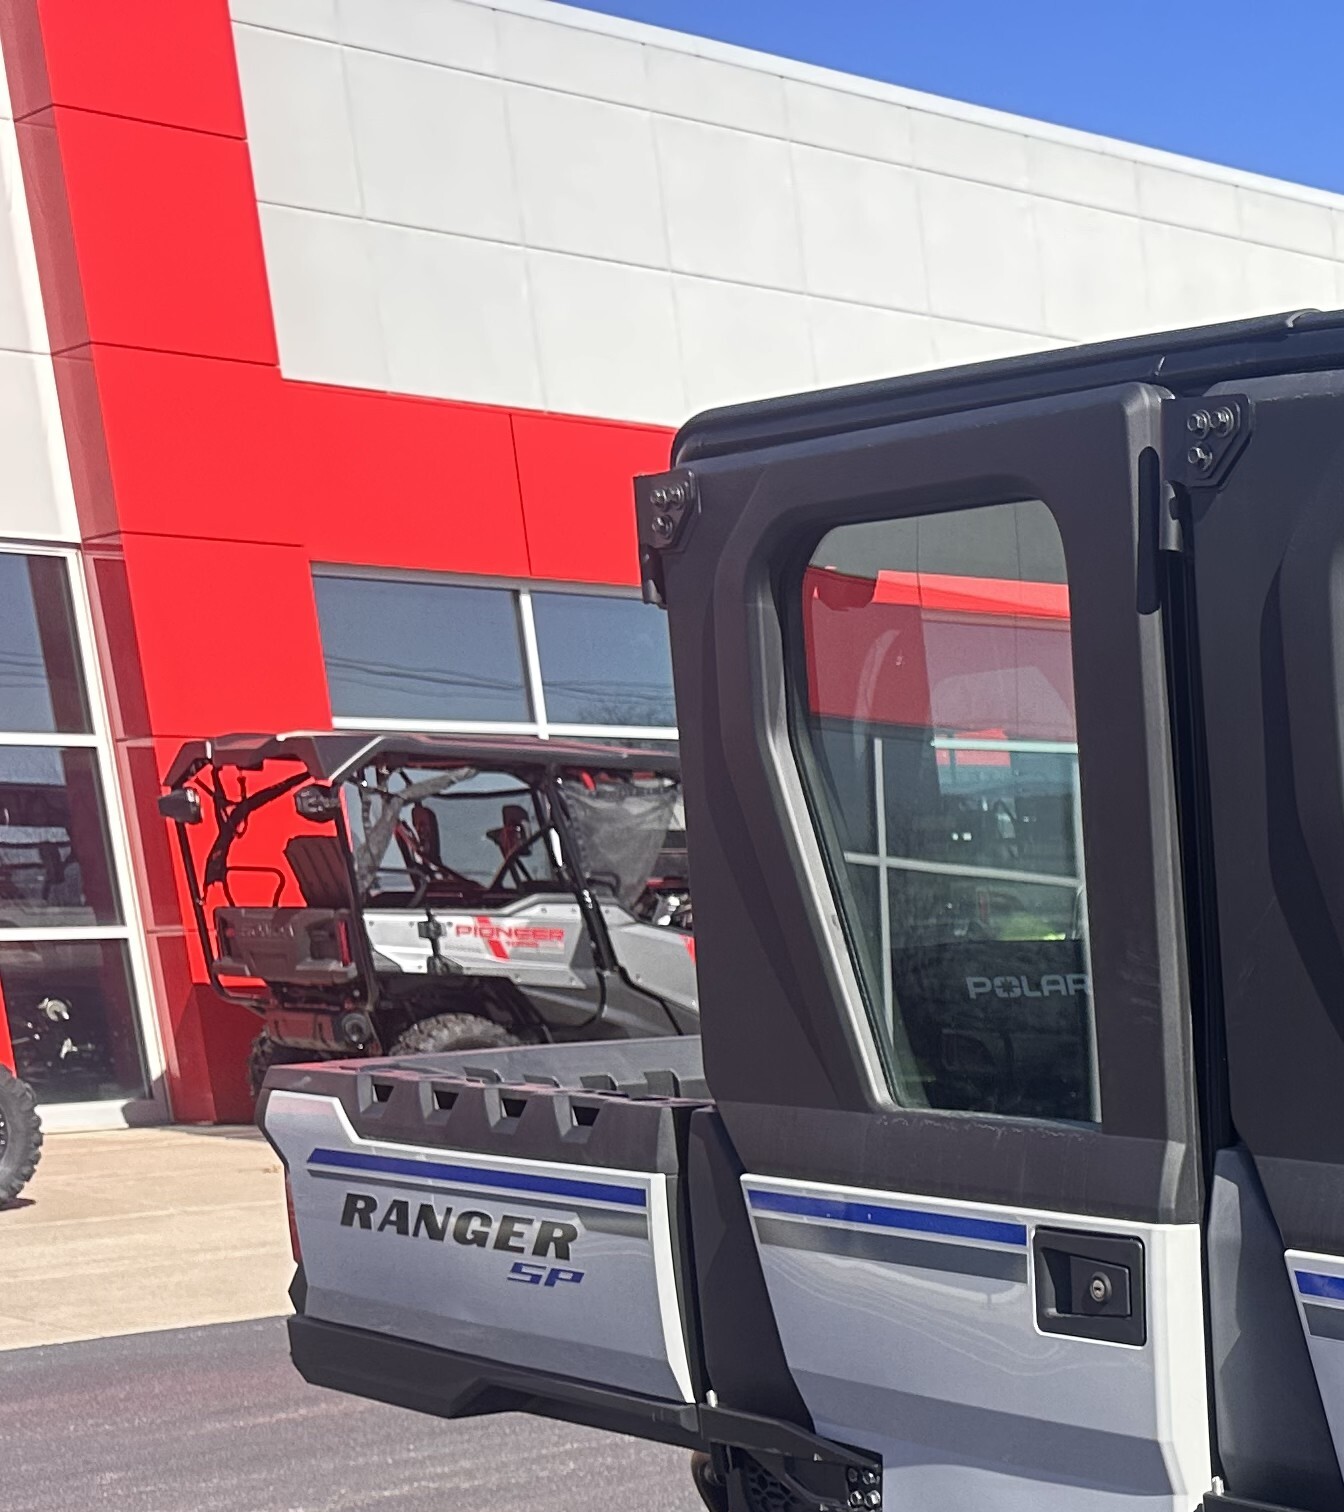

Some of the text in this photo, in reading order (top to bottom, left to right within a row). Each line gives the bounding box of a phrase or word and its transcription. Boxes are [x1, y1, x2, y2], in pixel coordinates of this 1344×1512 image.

[455, 924, 565, 941] PIONEER
[340, 1192, 578, 1261] RANGER
[507, 1262, 585, 1287] SP
